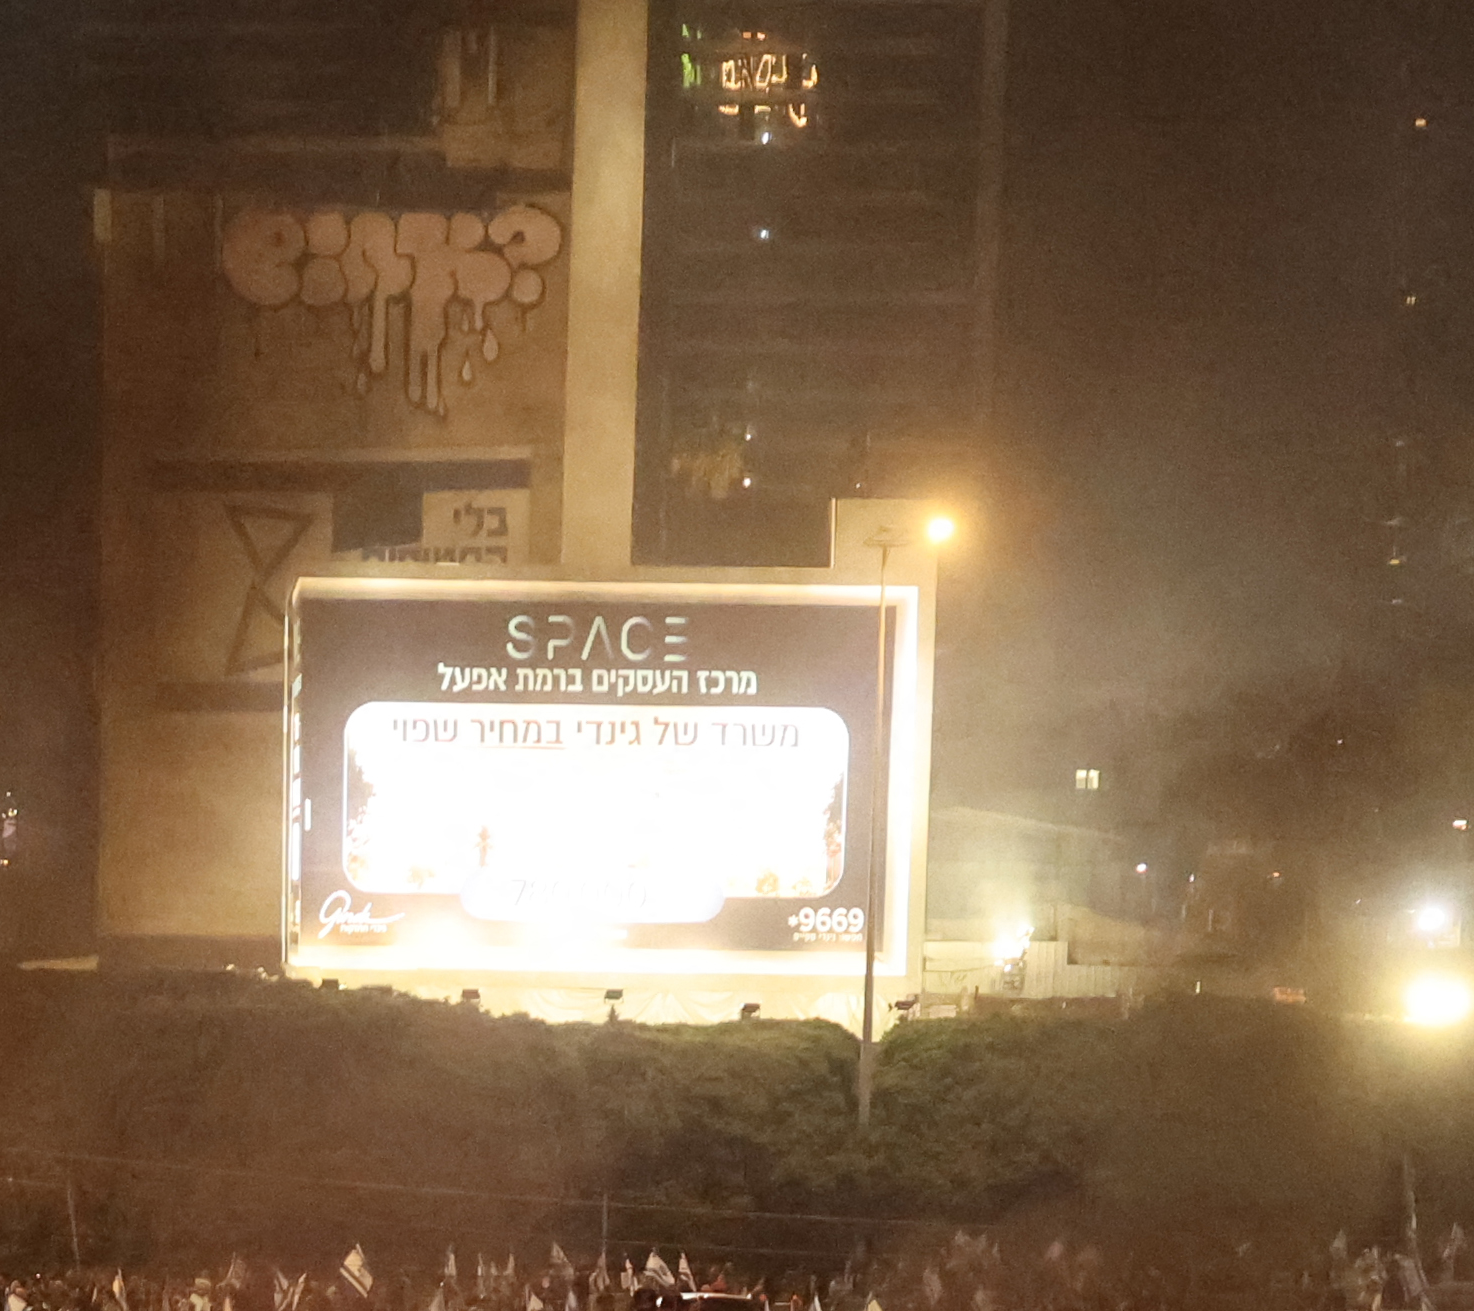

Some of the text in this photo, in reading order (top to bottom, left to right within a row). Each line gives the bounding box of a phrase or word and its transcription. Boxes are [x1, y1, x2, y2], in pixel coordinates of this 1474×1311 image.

[505, 614, 690, 662] SPACE
[437, 662, 758, 697] מרכז העסקים ברמת אפעל
[392, 716, 800, 748] משרד של גינדי במחיר שפוי
